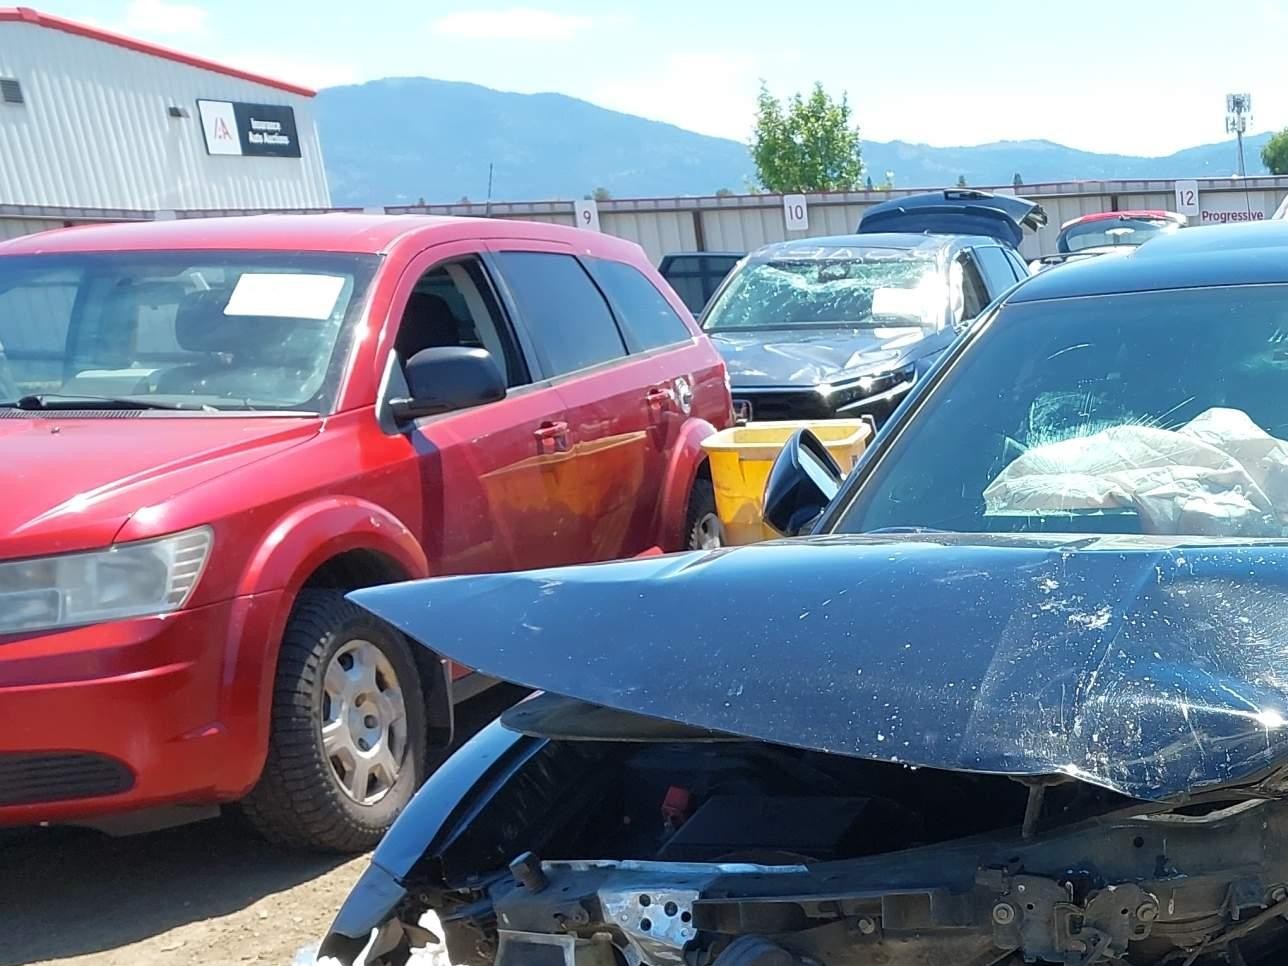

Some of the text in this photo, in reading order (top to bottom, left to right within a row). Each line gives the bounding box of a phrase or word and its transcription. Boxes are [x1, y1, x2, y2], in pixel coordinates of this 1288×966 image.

[1180, 190, 1195, 206] 12
[583, 210, 592, 225] 9
[788, 204, 804, 221] 10
[1202, 210, 1264, 223] Progressive
